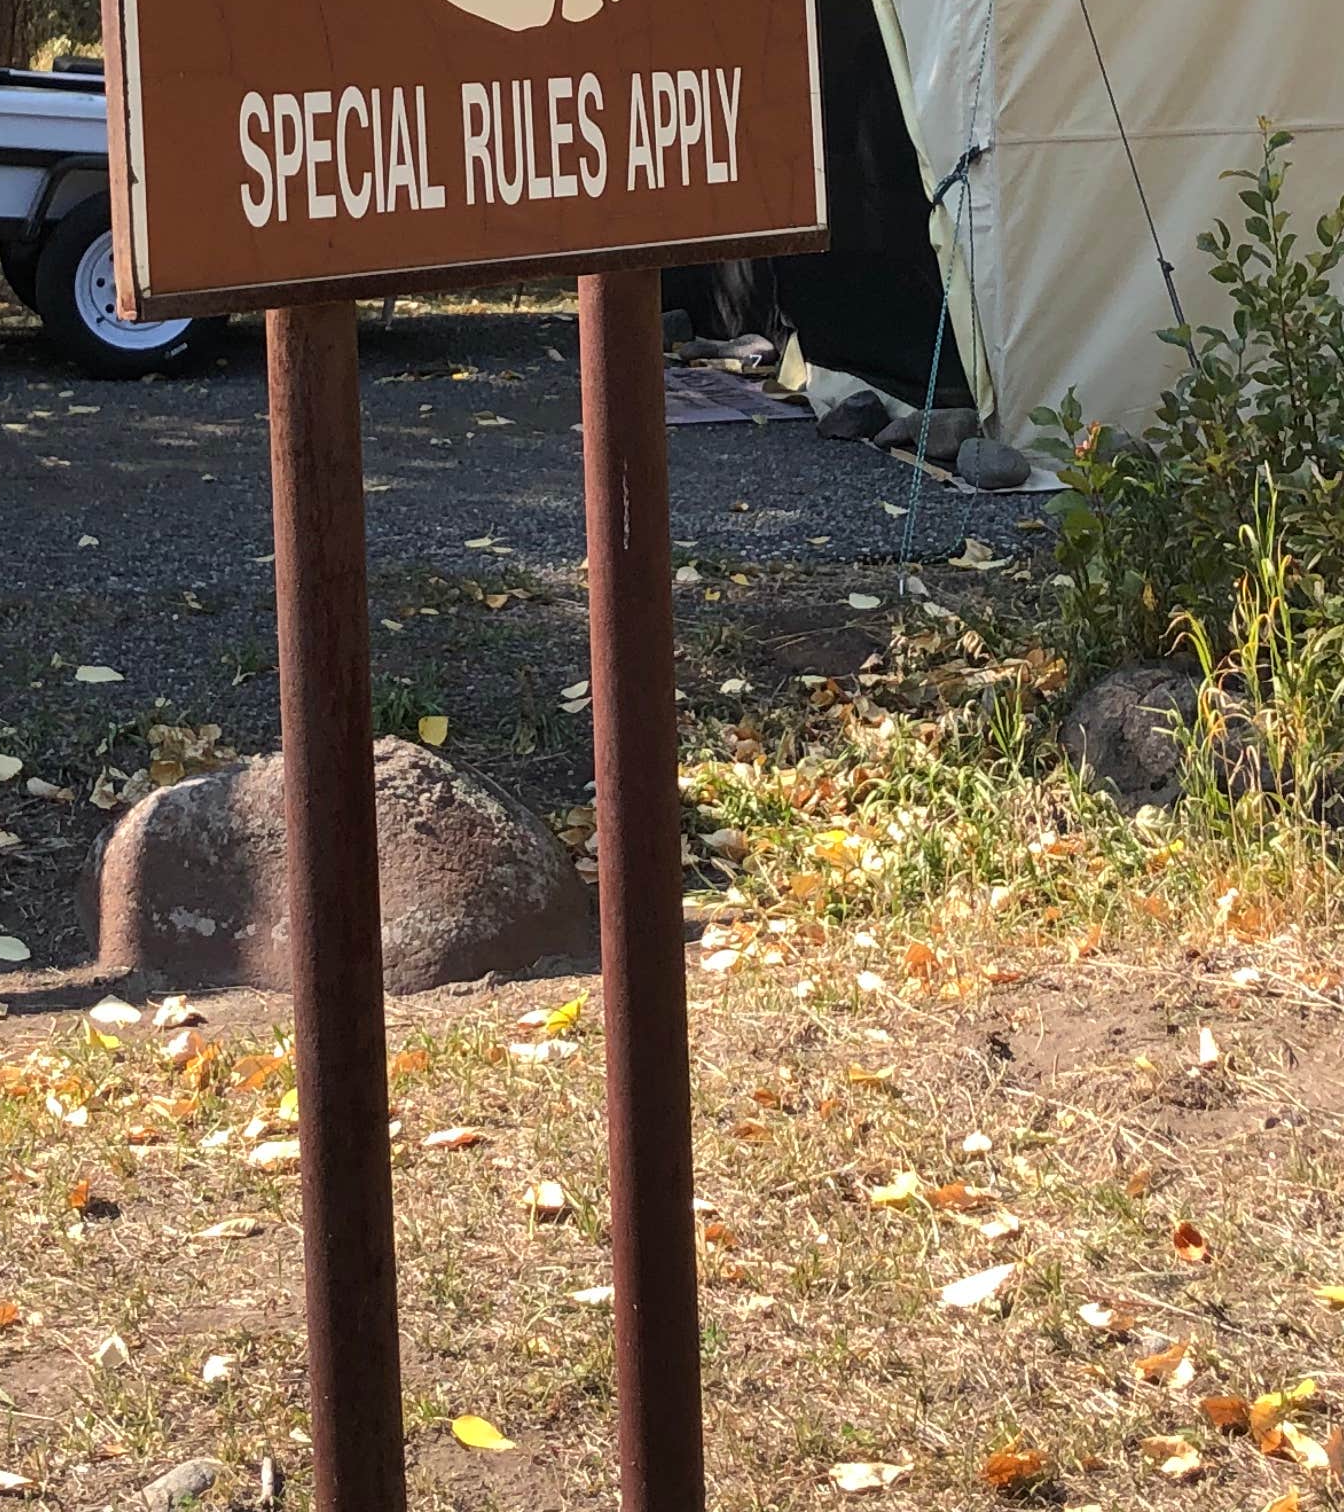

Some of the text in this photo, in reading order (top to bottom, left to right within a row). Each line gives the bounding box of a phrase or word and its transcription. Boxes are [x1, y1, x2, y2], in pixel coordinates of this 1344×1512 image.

[239, 67, 741, 228] SPECIAL RULES APPLY
